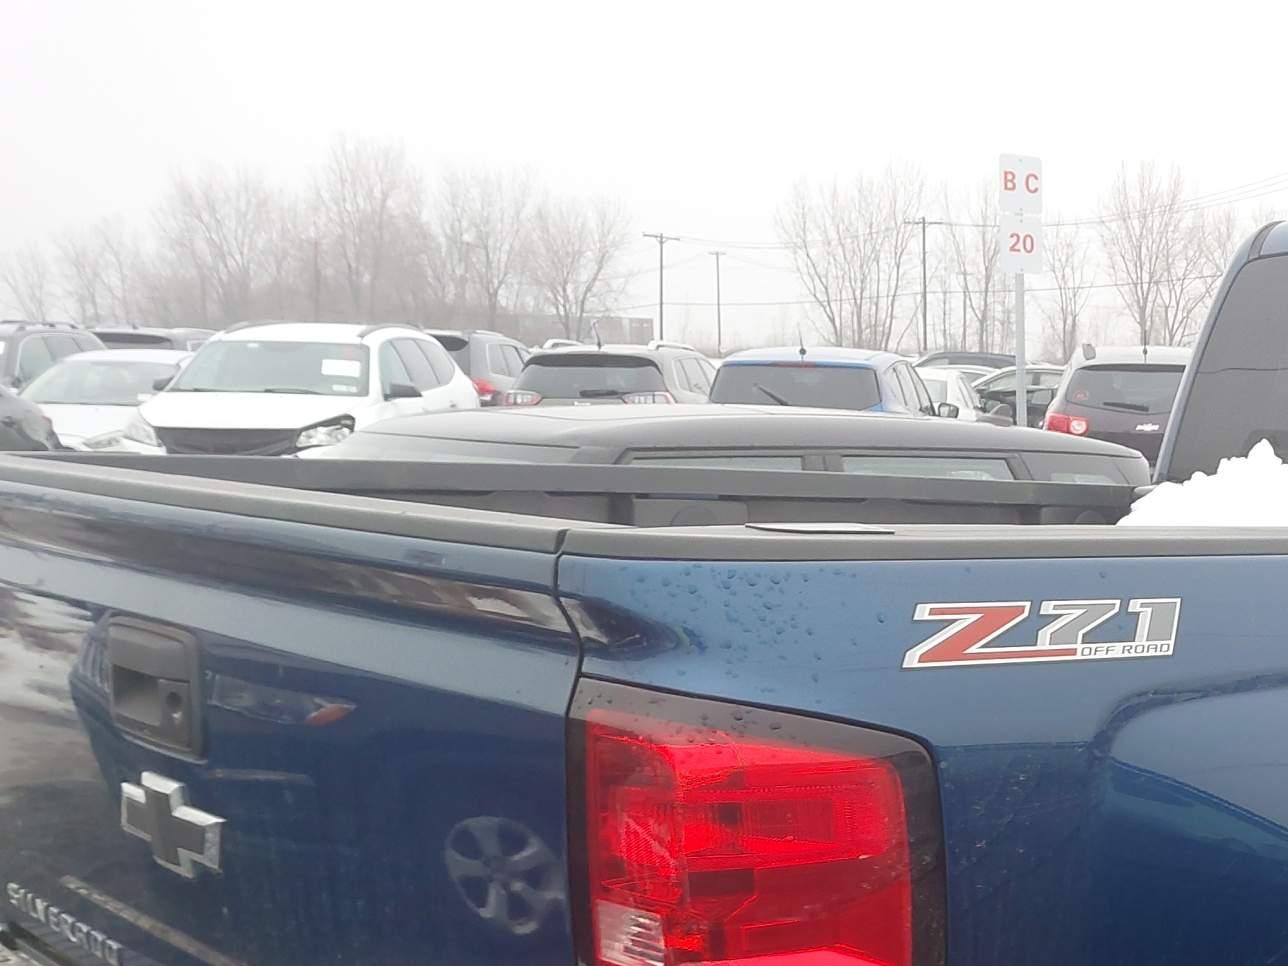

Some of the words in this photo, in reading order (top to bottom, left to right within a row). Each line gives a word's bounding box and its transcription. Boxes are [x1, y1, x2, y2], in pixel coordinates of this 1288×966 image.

[1003, 170, 1017, 191] B
[1025, 173, 1039, 194] C
[1008, 232, 1035, 254] 20
[902, 598, 1182, 668] Z71
[1081, 645, 1117, 657] OFF
[1121, 643, 1171, 656] ROAD
